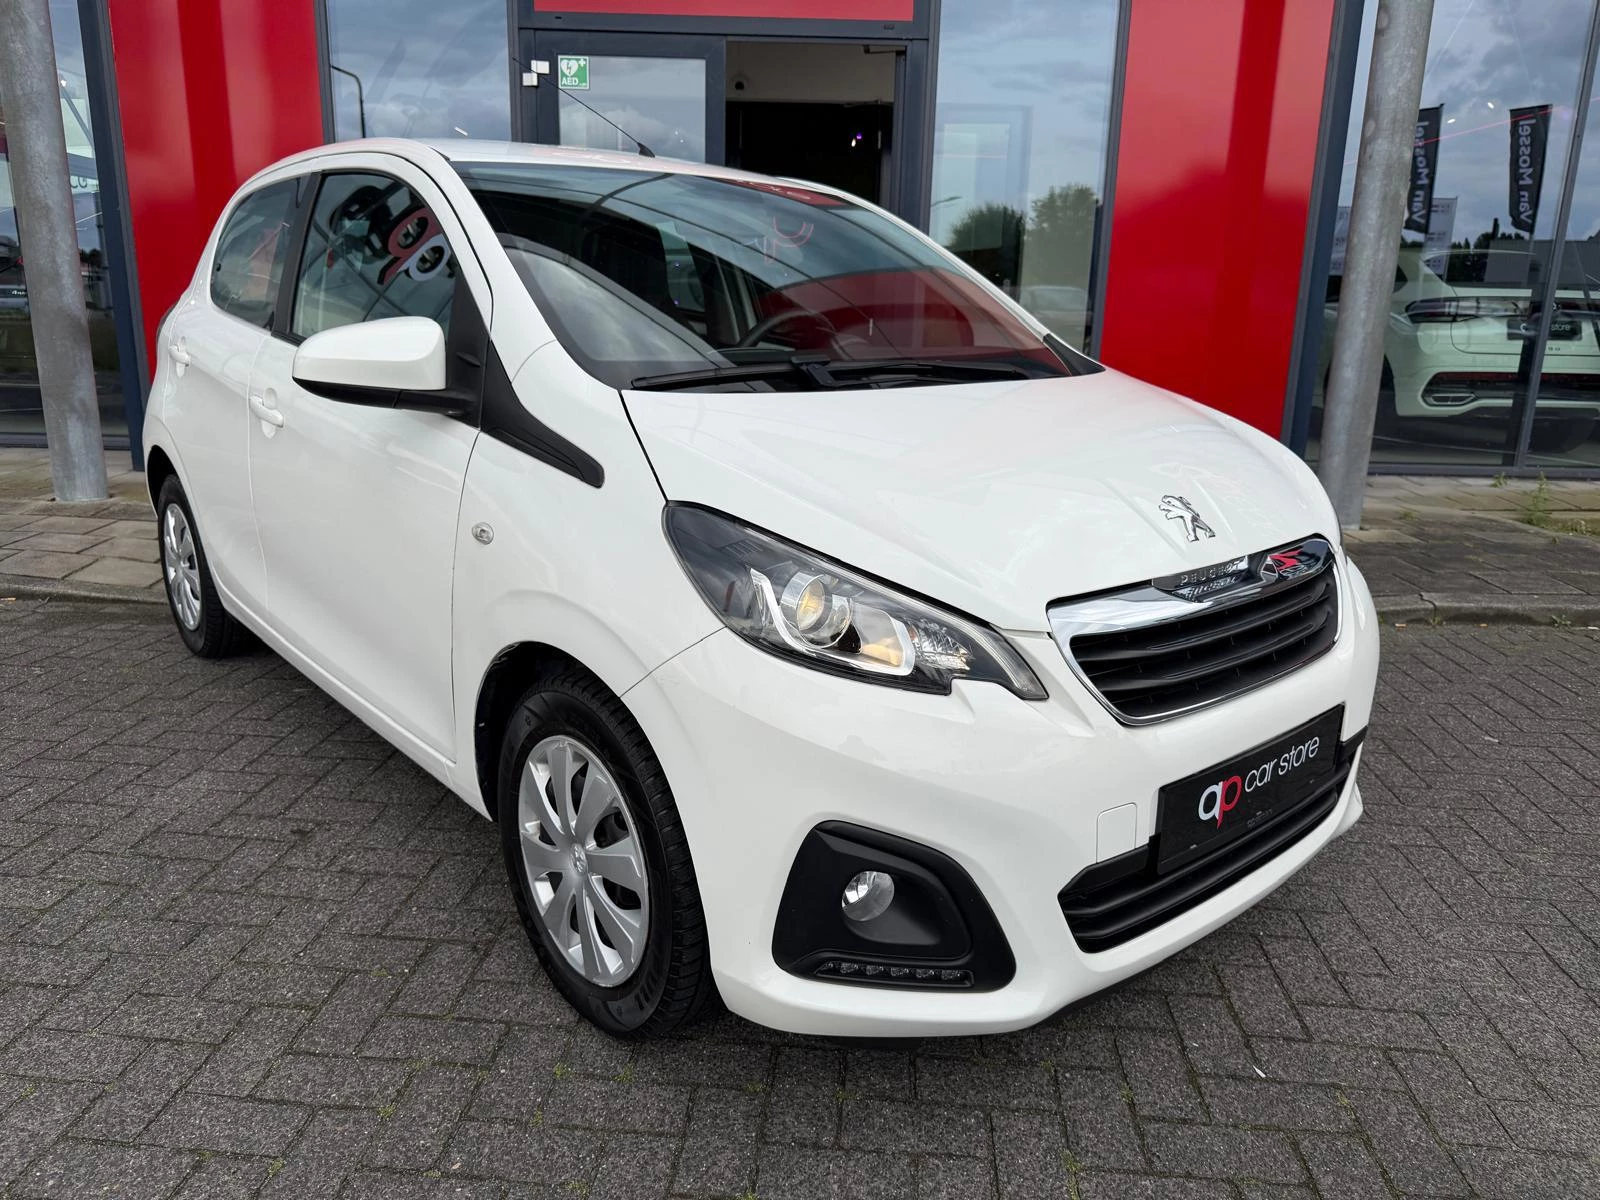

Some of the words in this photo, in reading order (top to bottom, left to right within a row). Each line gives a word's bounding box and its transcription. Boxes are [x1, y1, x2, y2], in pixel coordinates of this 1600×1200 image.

[562, 77, 579, 86] AED
[1180, 560, 1240, 586] PEUGEOT
[1244, 757, 1277, 793] car
[1278, 736, 1320, 776] store
